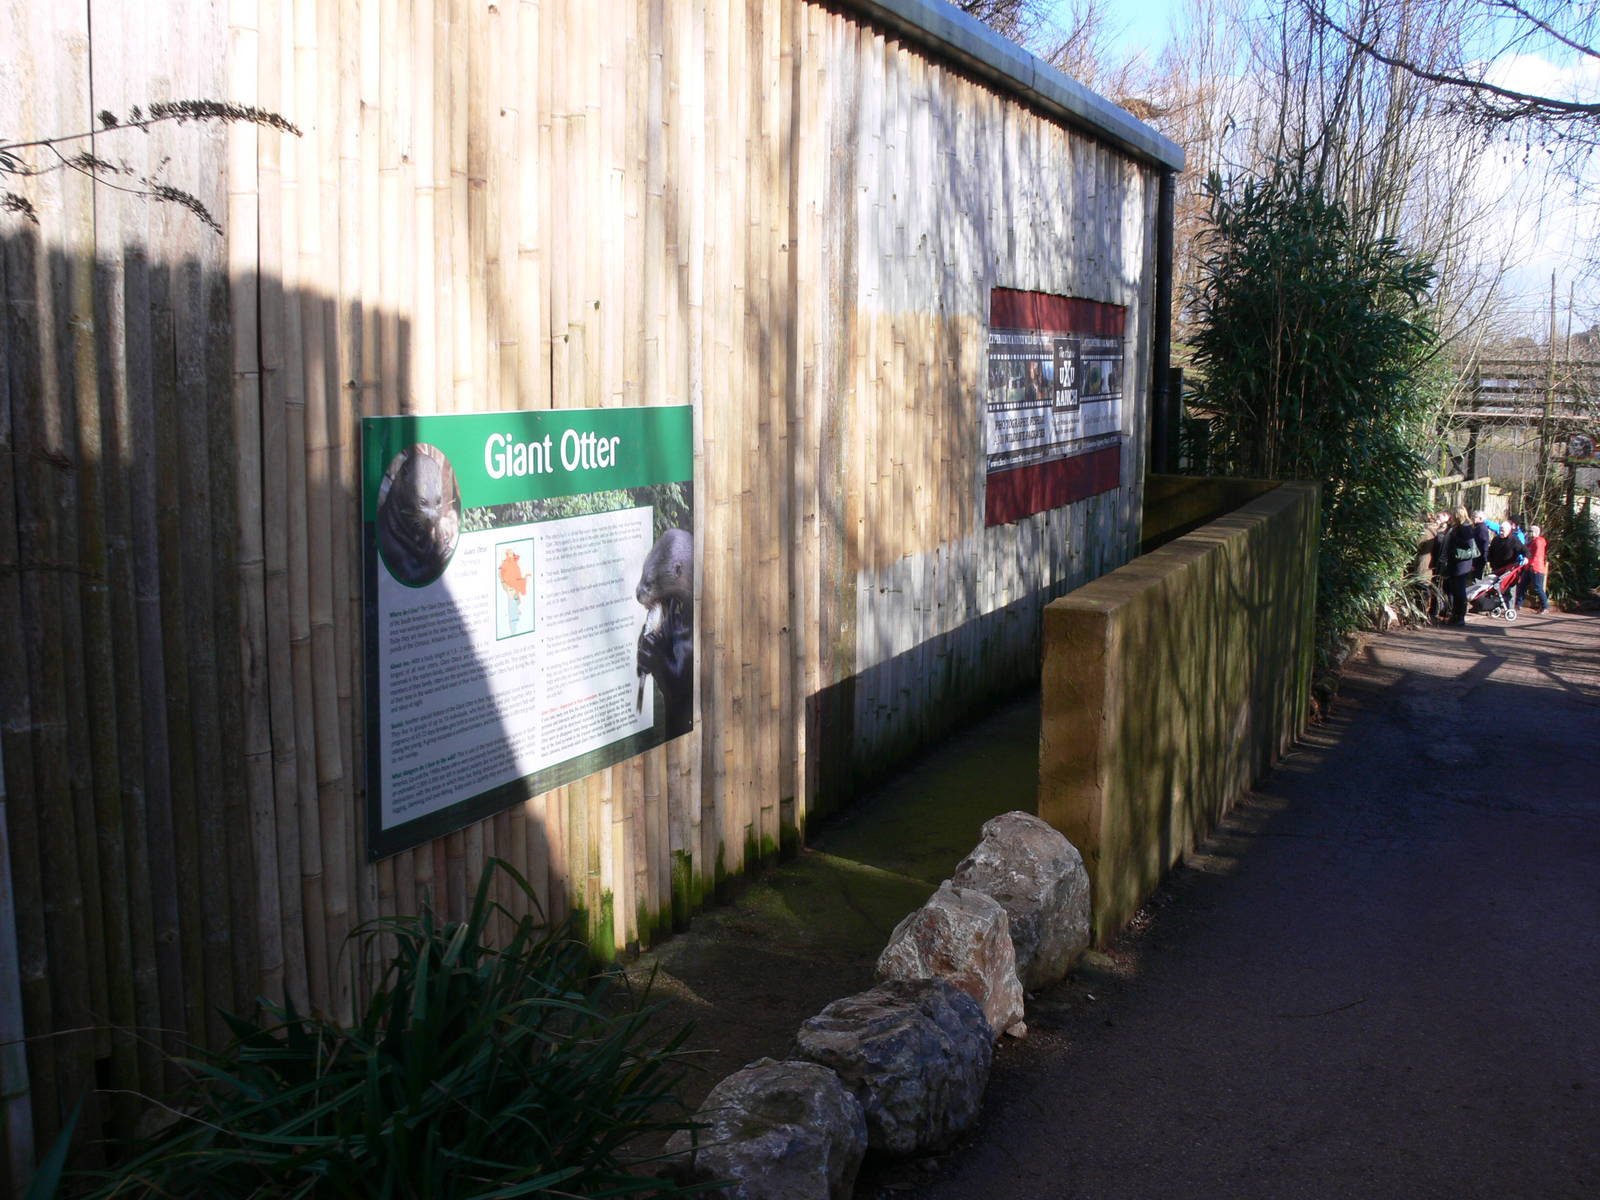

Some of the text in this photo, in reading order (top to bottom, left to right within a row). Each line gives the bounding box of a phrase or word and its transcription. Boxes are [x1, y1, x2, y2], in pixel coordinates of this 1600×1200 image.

[1056, 389, 1078, 407] RANCH
[484, 429, 620, 479] Giant Otter
